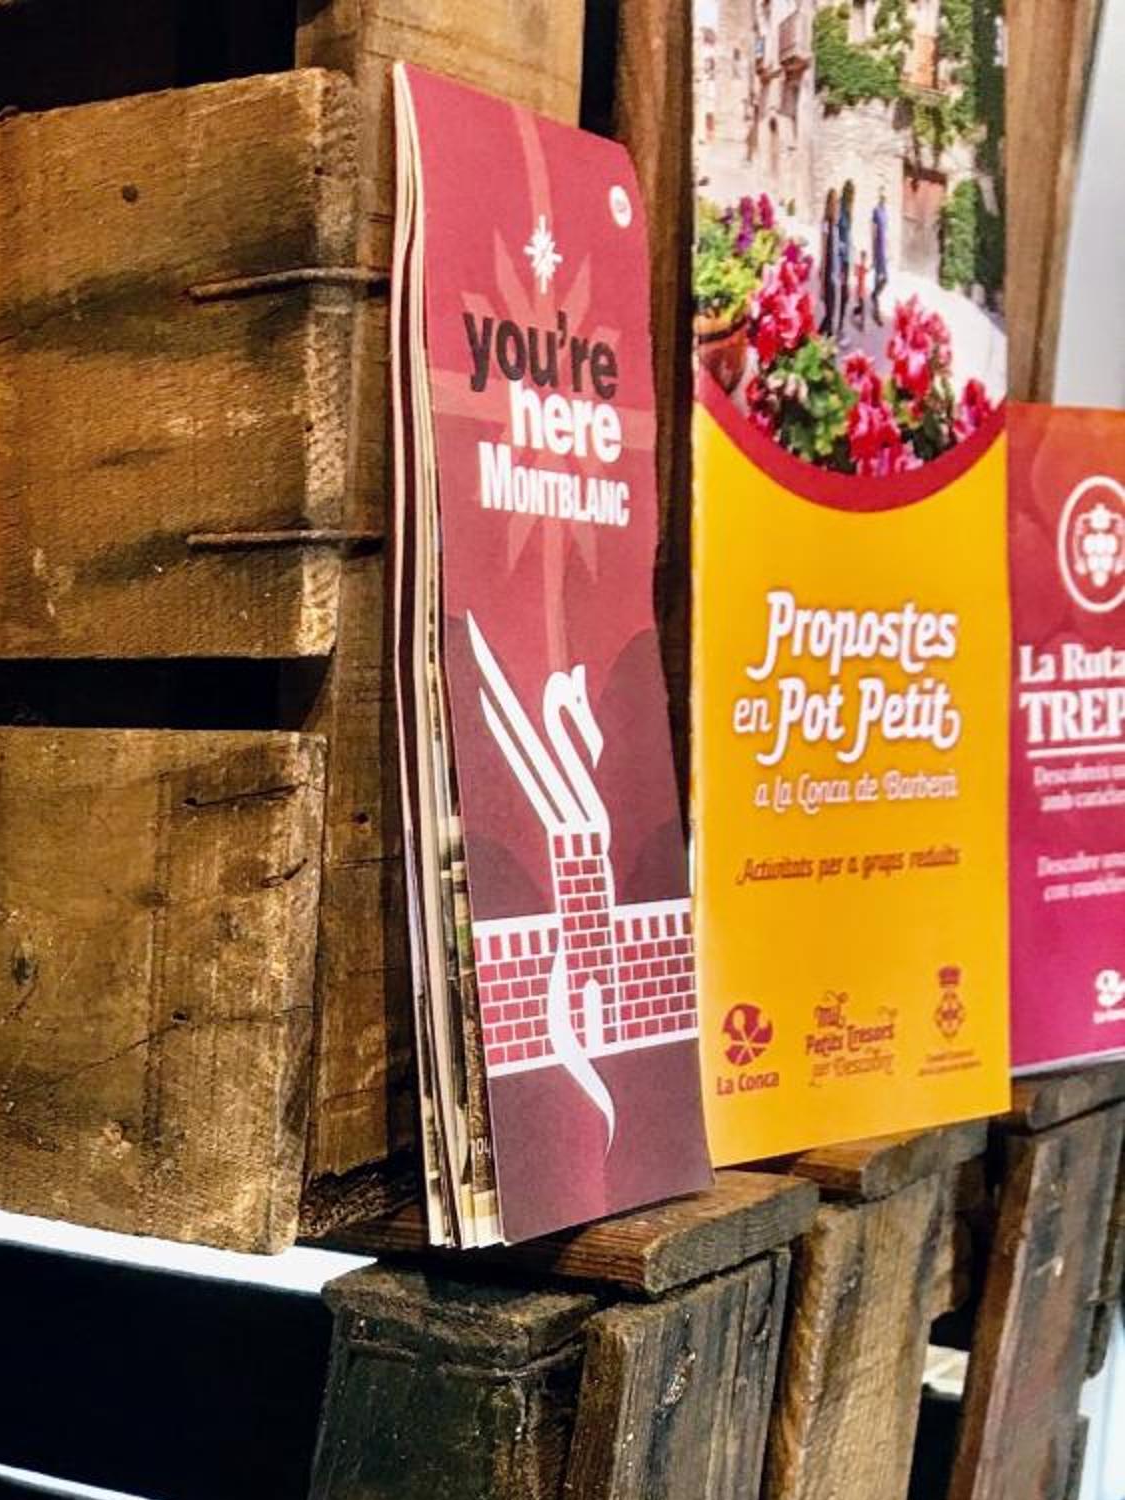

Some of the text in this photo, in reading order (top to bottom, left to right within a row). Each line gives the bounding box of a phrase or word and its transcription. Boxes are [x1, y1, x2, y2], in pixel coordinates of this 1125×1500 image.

[462, 311, 618, 400] you're
[509, 378, 621, 463] here
[746, 590, 957, 680] Propostes
[1019, 645, 1056, 683] La
[734, 677, 961, 765] en Pot Petit
[755, 782, 769, 806] a
[716, 1071, 780, 1096] La Conca
